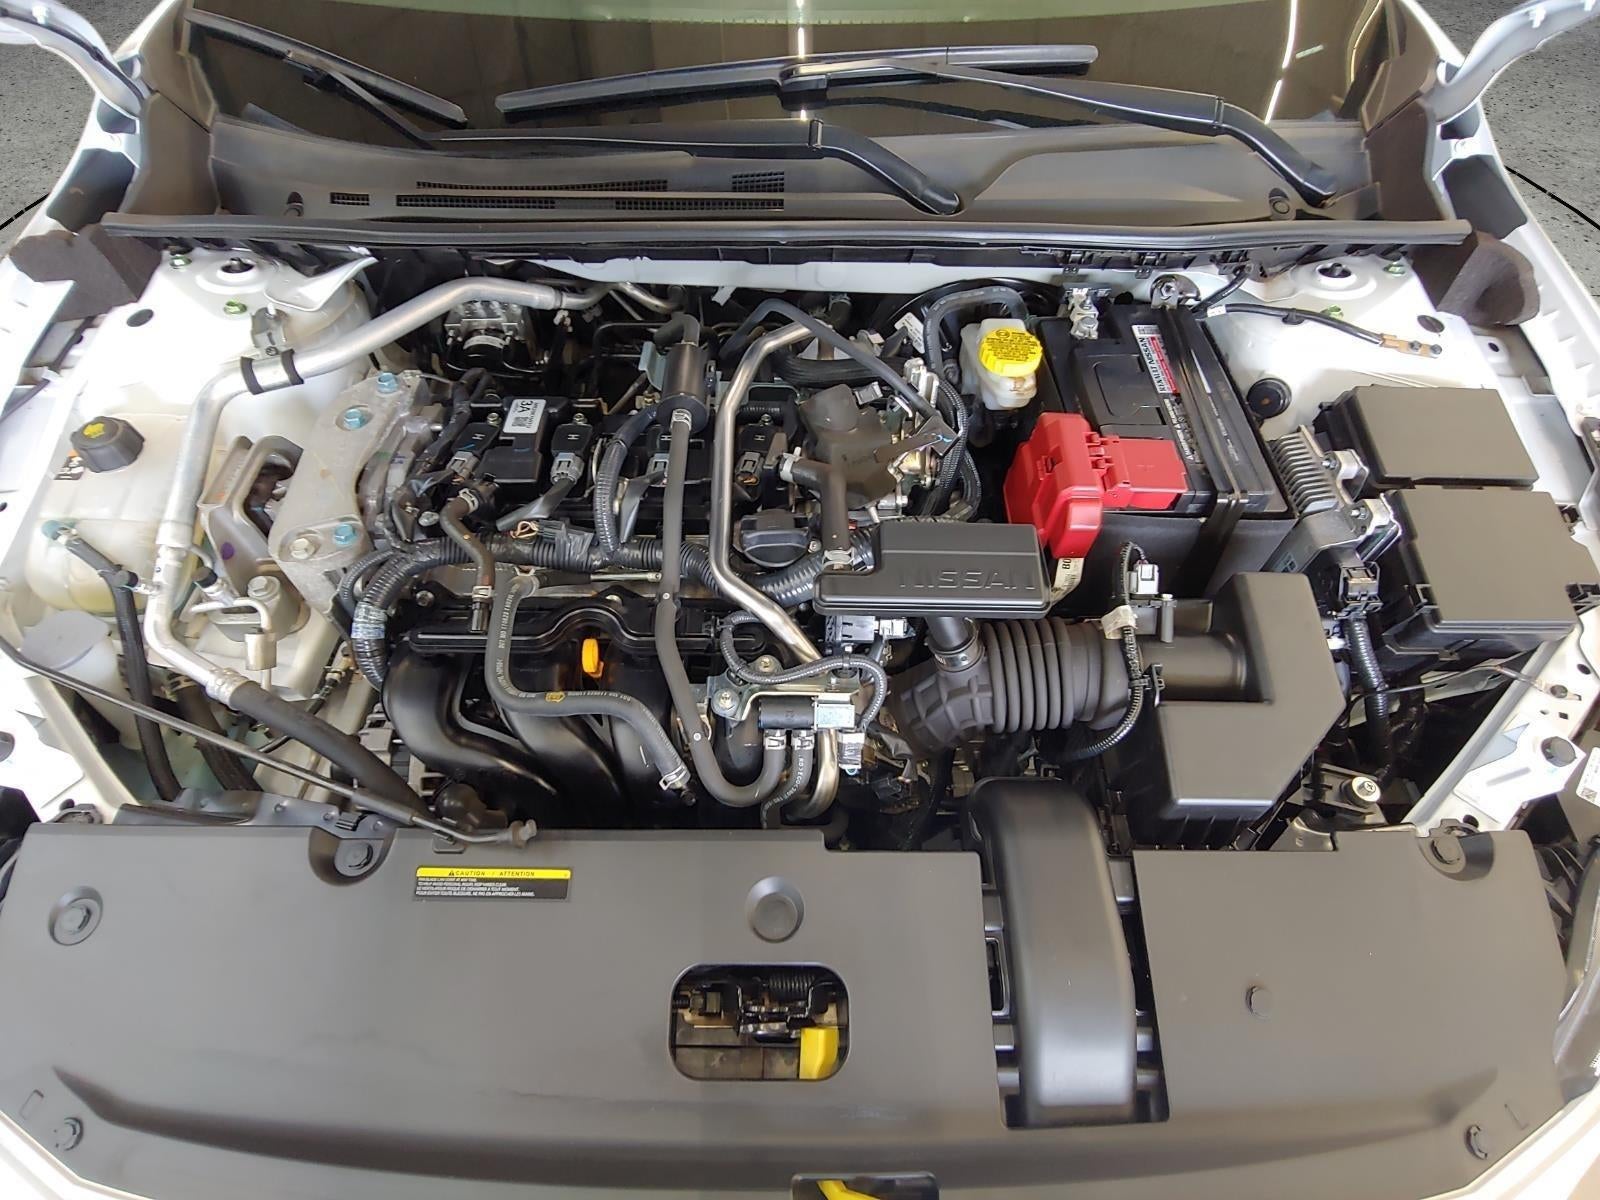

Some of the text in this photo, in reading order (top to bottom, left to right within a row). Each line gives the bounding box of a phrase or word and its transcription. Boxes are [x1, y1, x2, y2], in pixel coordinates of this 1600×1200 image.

[1138, 337, 1155, 365] NISSAN
[517, 400, 534, 413] 3A
[899, 571, 1036, 590] NISSAN
